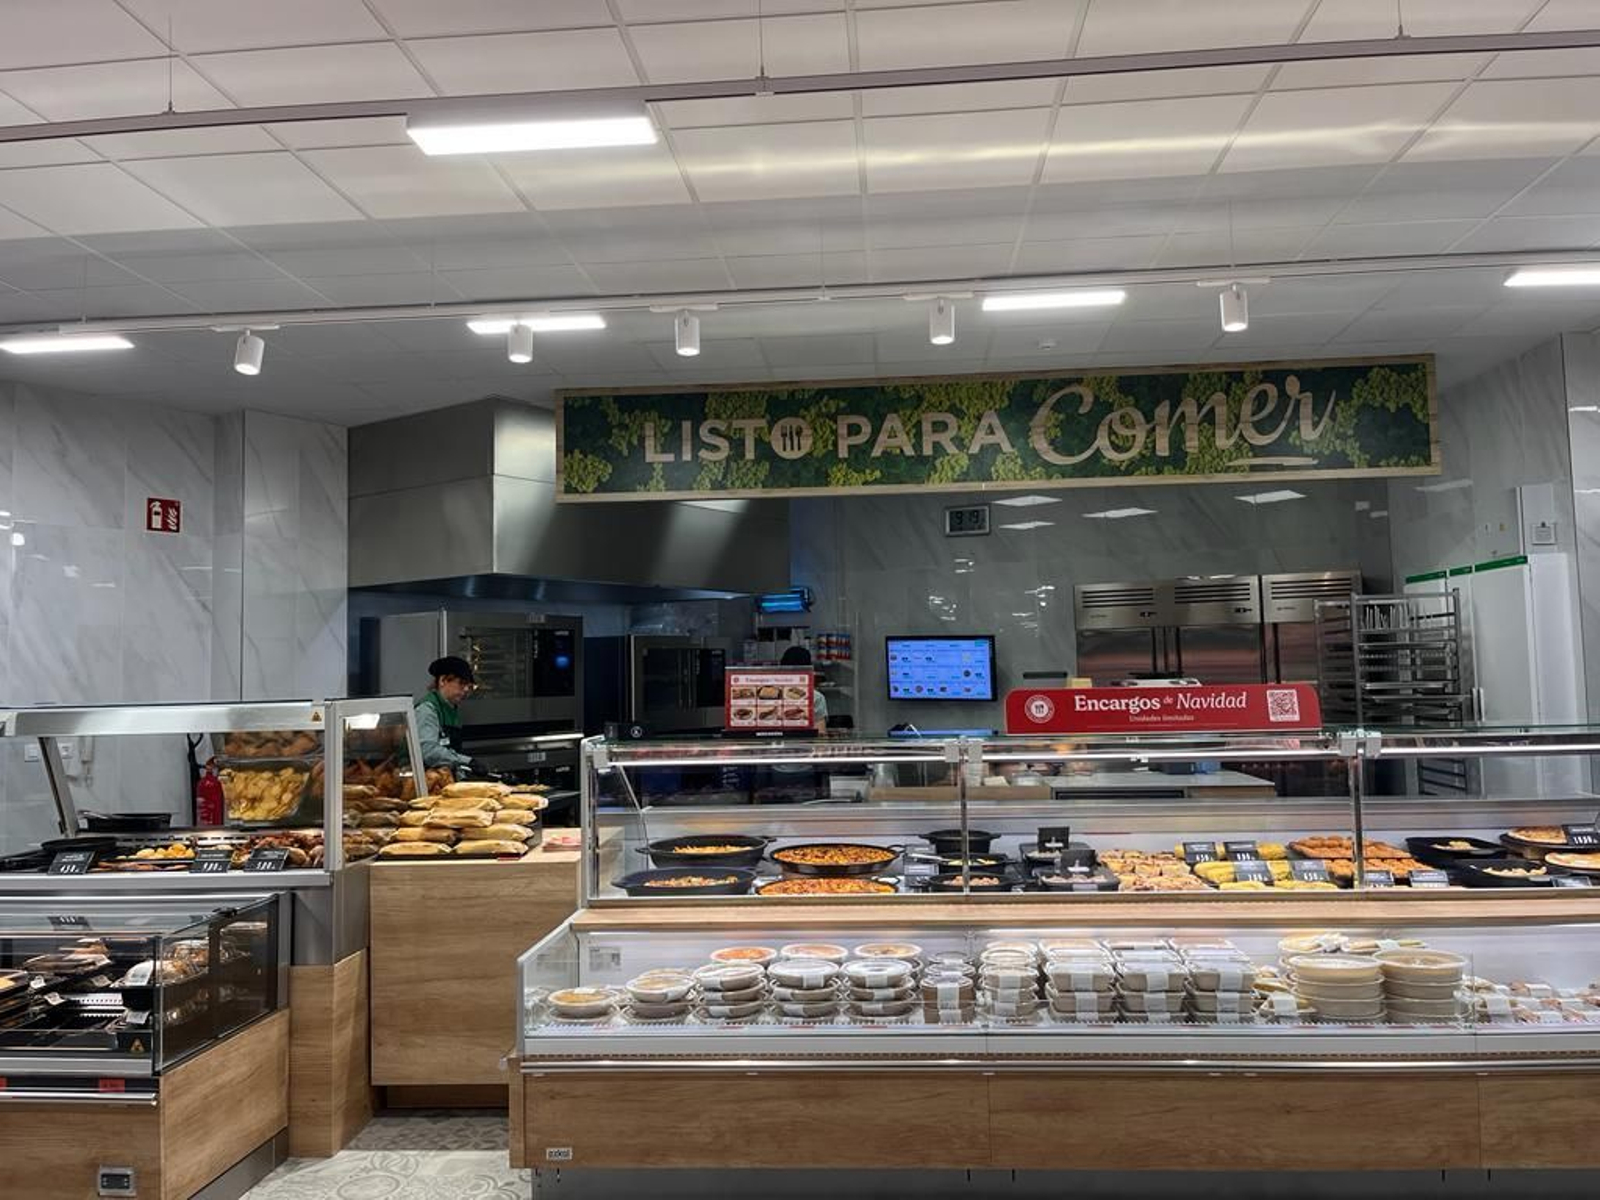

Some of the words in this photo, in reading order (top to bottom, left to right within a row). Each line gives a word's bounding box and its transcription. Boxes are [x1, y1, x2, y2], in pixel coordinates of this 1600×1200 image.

[645, 413, 811, 463] LISTO
[837, 408, 1013, 459] PARA
[1031, 374, 1334, 466] Comer
[1074, 694, 1160, 714] Encargos
[1163, 696, 1173, 705] de
[1177, 691, 1246, 710] Navidad
